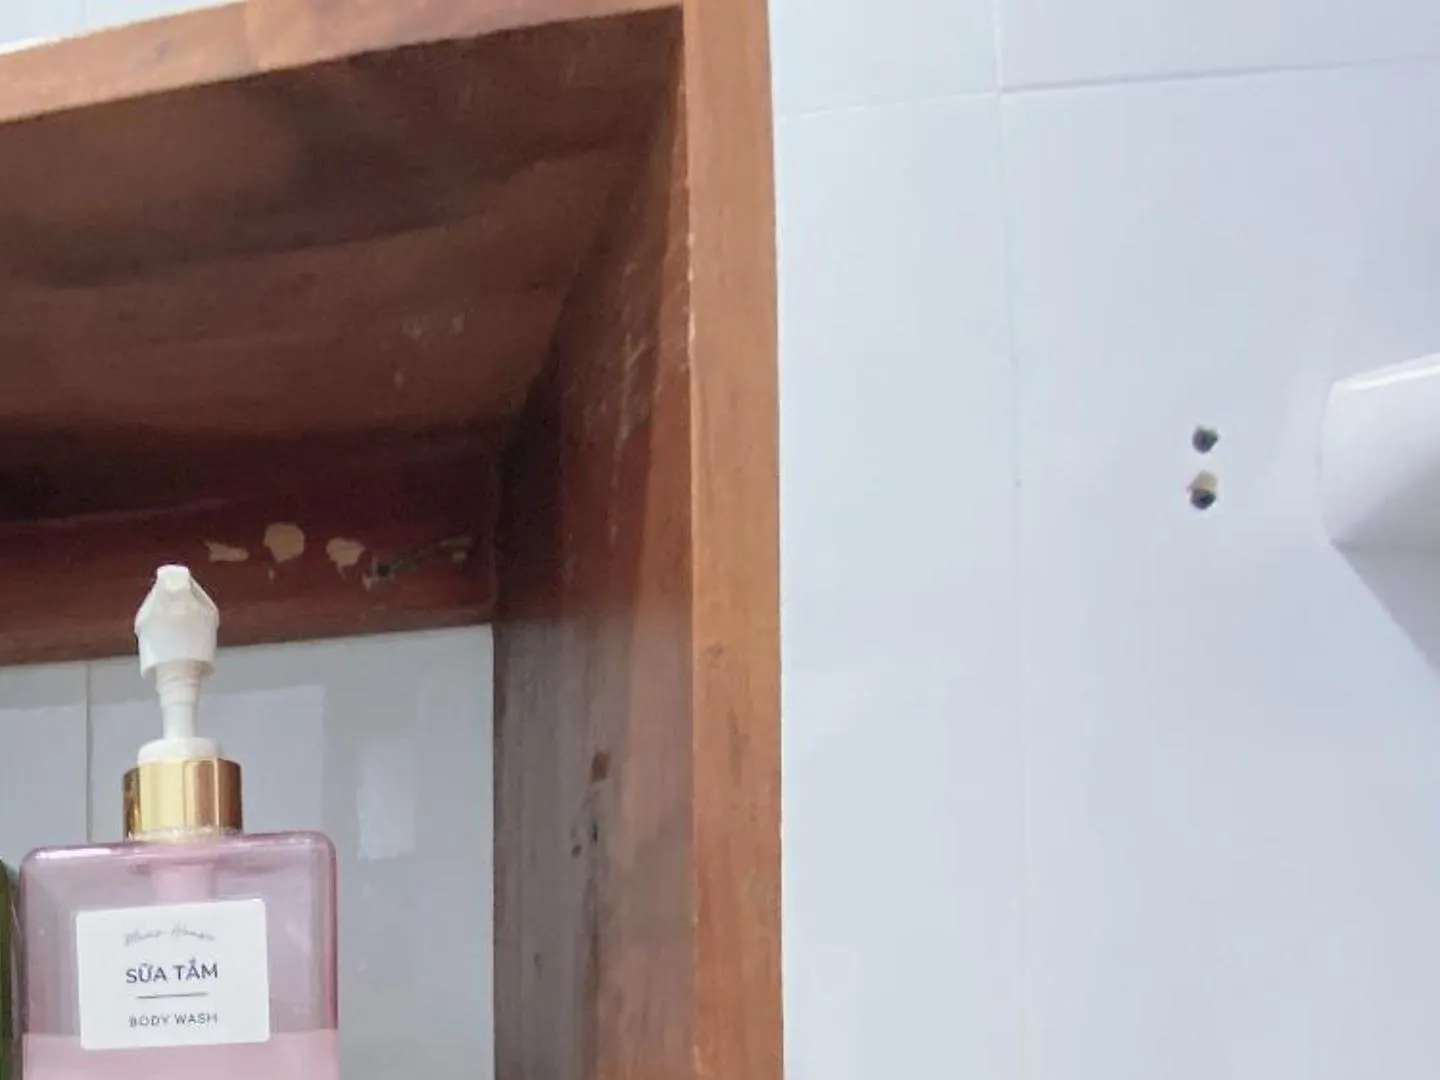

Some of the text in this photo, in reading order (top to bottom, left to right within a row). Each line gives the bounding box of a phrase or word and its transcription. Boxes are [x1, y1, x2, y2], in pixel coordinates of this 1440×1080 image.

[125, 962, 169, 984] SỮA
[129, 1011, 218, 1028] BODY WASH
